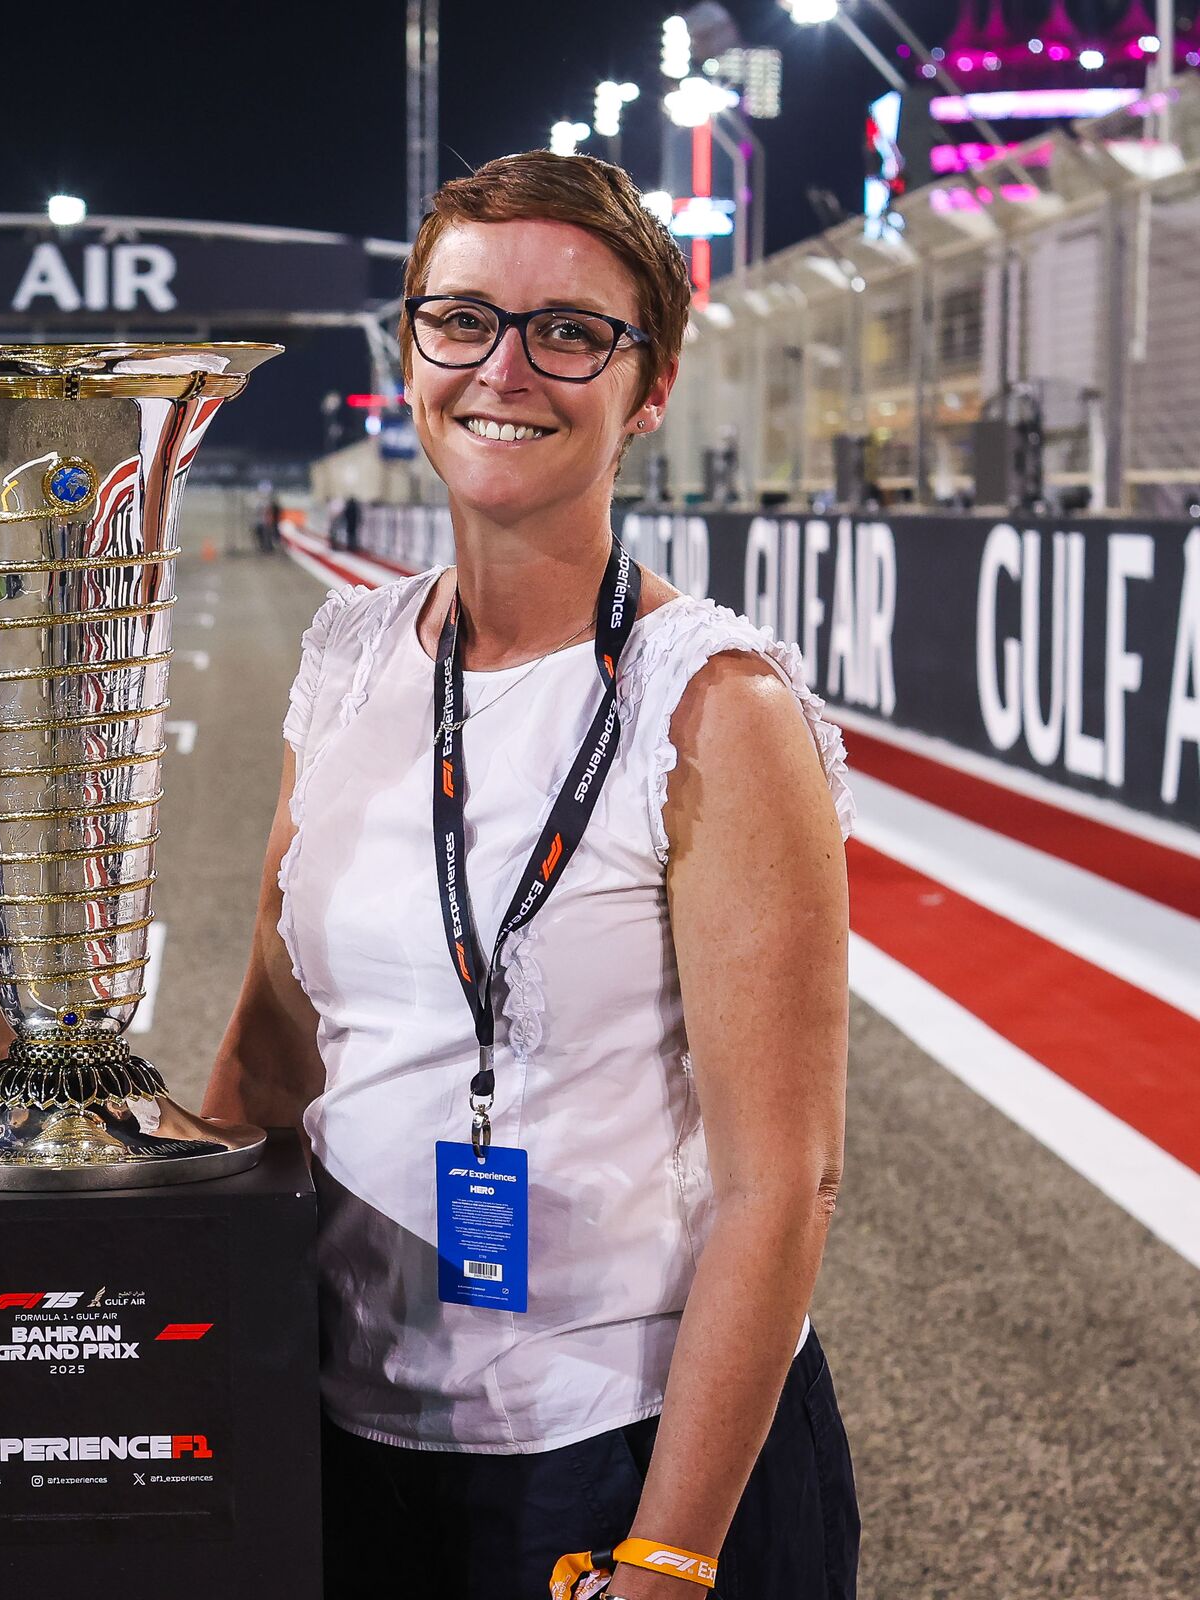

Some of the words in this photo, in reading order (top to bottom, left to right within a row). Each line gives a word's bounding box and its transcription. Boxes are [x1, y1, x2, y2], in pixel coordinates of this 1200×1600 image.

[11, 244, 177, 311] AIR
[976, 523, 1155, 788] GULF
[574, 698, 617, 804] Experiences
[446, 831, 464, 940] Experiences
[469, 1169, 517, 1182] Experiences
[469, 1184, 495, 1196] HERO
[104, 1298, 129, 1306] GULF
[130, 1298, 146, 1306] AIR
[15, 1313, 60, 1322] FORMULA
[63, 1313, 69, 1321] 1
[76, 1312, 100, 1321] GULF
[102, 1312, 118, 1320] AIR
[11, 1324, 121, 1343] BAHRAIN
[82, 1342, 140, 1360] PRIX
[50, 1364, 86, 1374] 2025
[643, 1550, 698, 1572] F1
